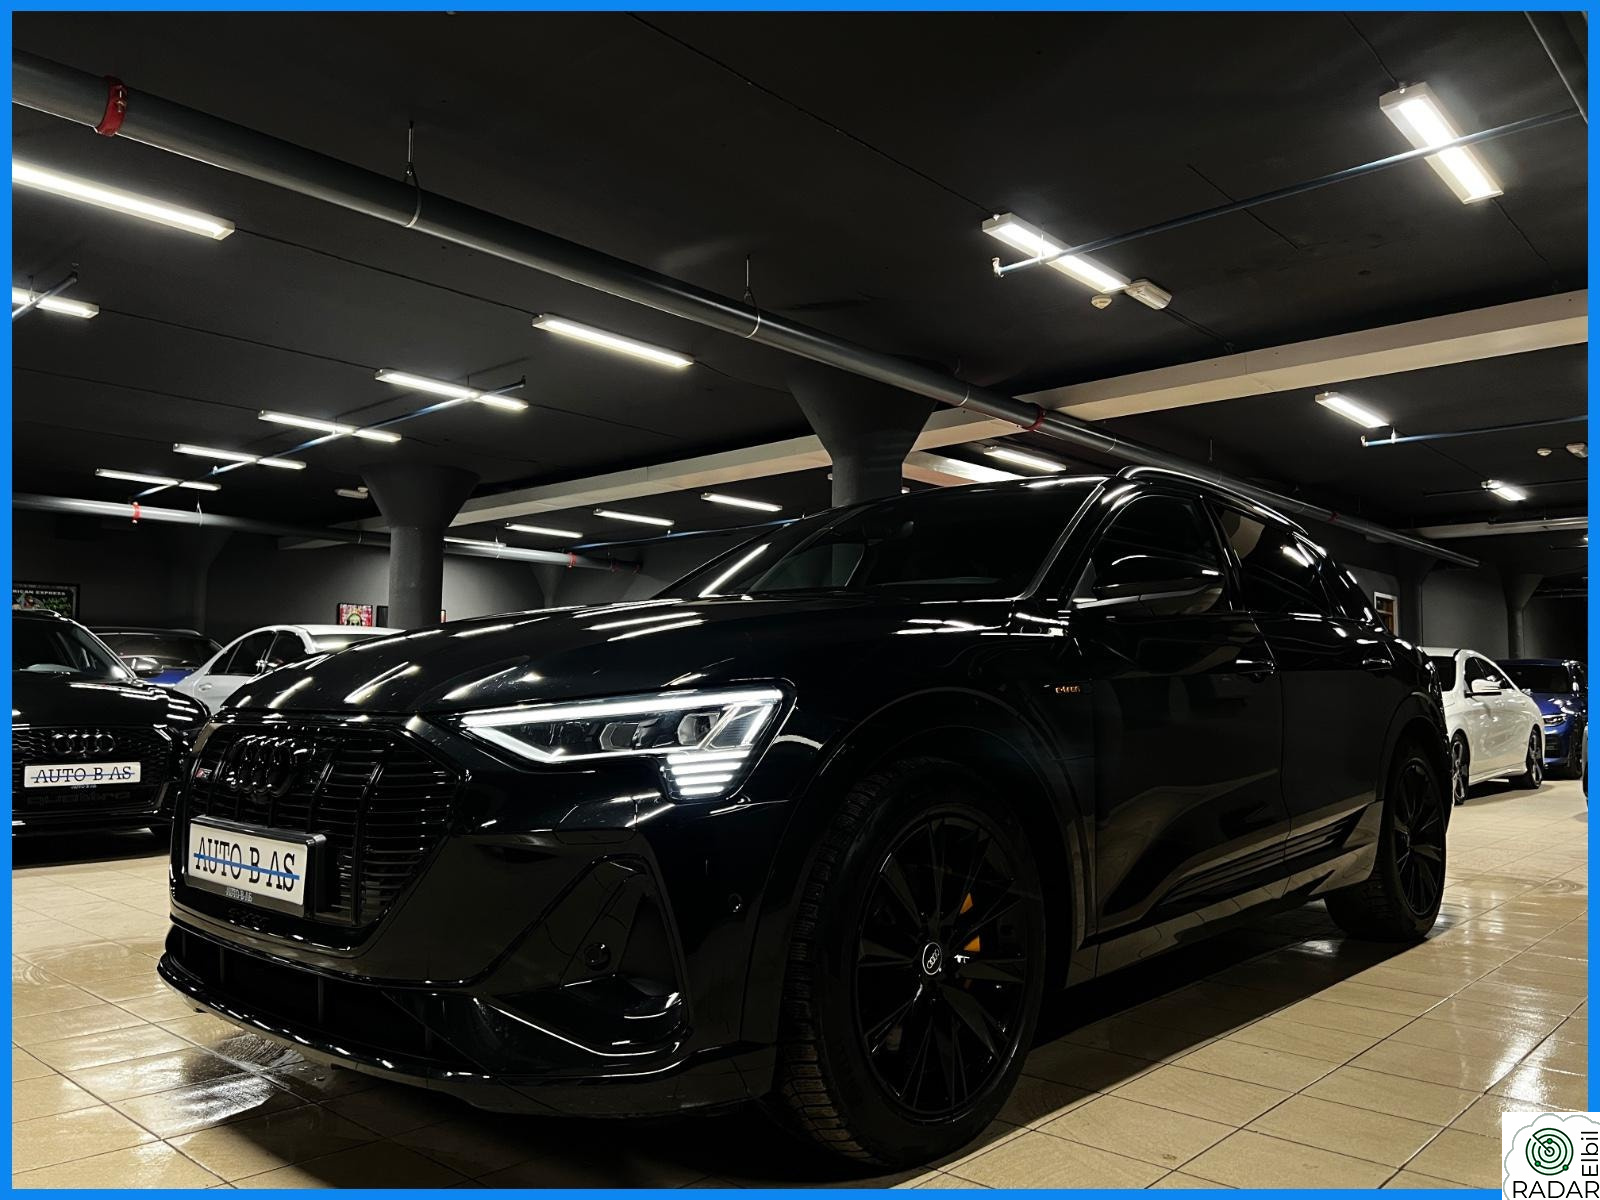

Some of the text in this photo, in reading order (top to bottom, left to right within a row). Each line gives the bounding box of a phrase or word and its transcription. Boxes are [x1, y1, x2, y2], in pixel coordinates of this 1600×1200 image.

[34, 766, 131, 783] AUTO B AS
[195, 837, 295, 892] AUTO B AS
